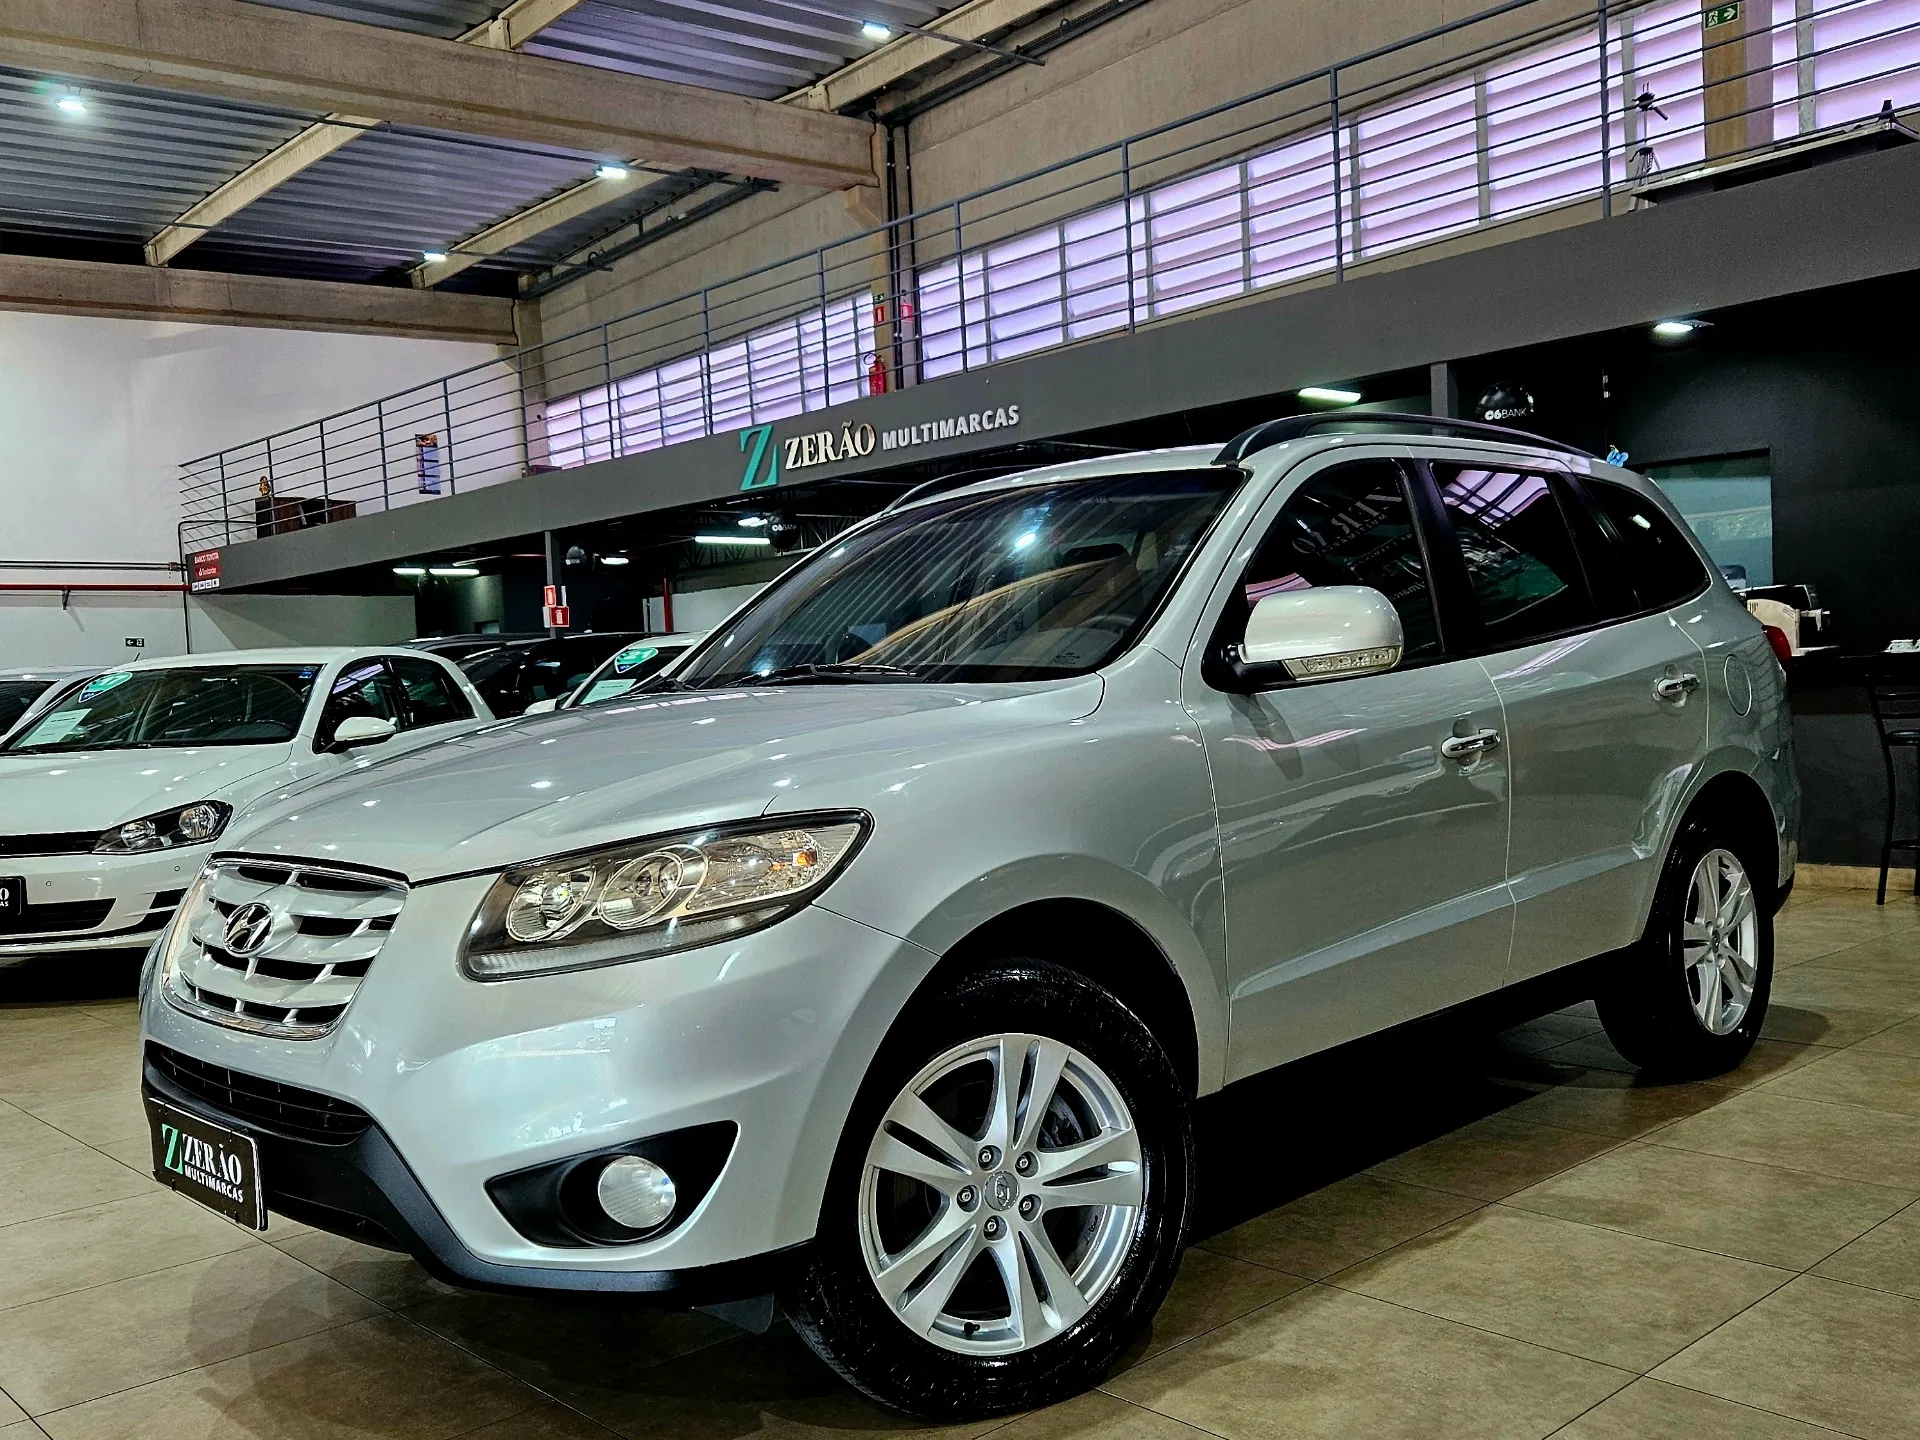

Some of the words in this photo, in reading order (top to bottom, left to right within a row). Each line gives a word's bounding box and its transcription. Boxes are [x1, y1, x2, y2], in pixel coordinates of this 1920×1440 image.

[739, 424, 779, 491] Z
[784, 420, 876, 470] ZERÃO
[882, 405, 1020, 450] MULTIMARCAS
[161, 1123, 183, 1175] Z
[182, 1133, 242, 1185] ZERÃO
[184, 1164, 243, 1203] MULTIMARCAS
